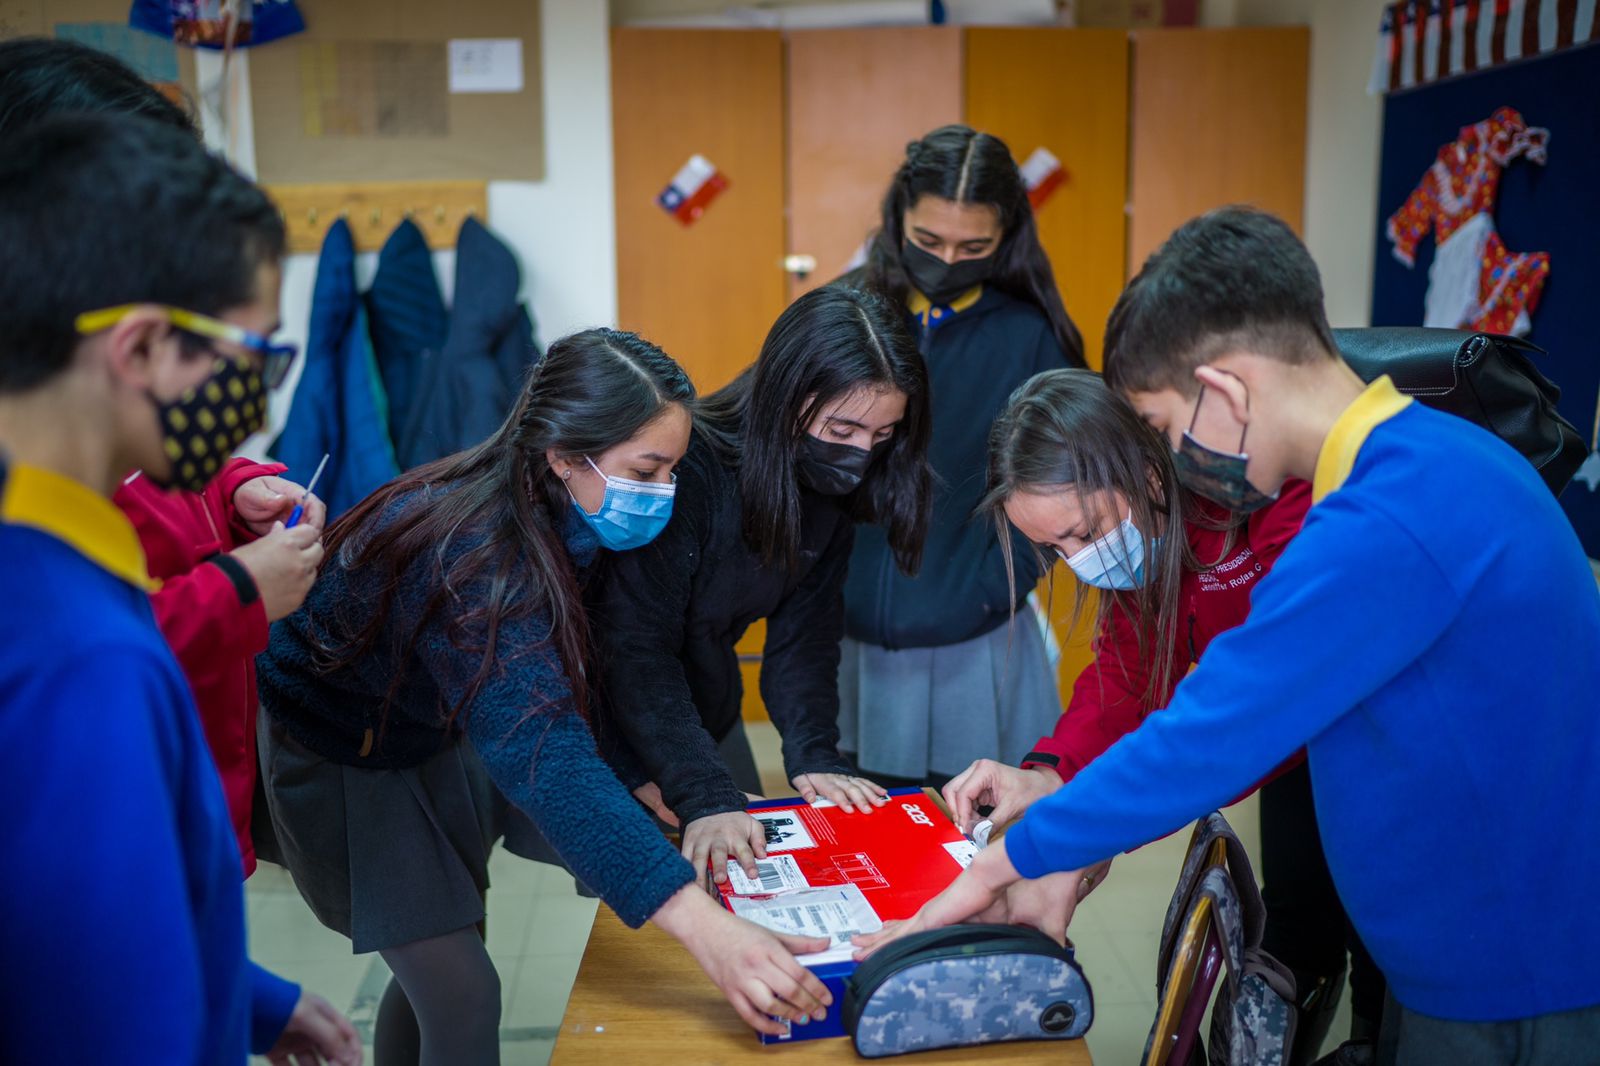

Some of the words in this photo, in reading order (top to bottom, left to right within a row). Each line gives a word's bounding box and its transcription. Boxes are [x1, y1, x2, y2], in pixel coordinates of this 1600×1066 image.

[1215, 547, 1253, 574] PRESIDENCIAL
[1229, 570, 1255, 588] Rojas
[1254, 562, 1262, 571] G
[901, 803, 934, 827] acer
